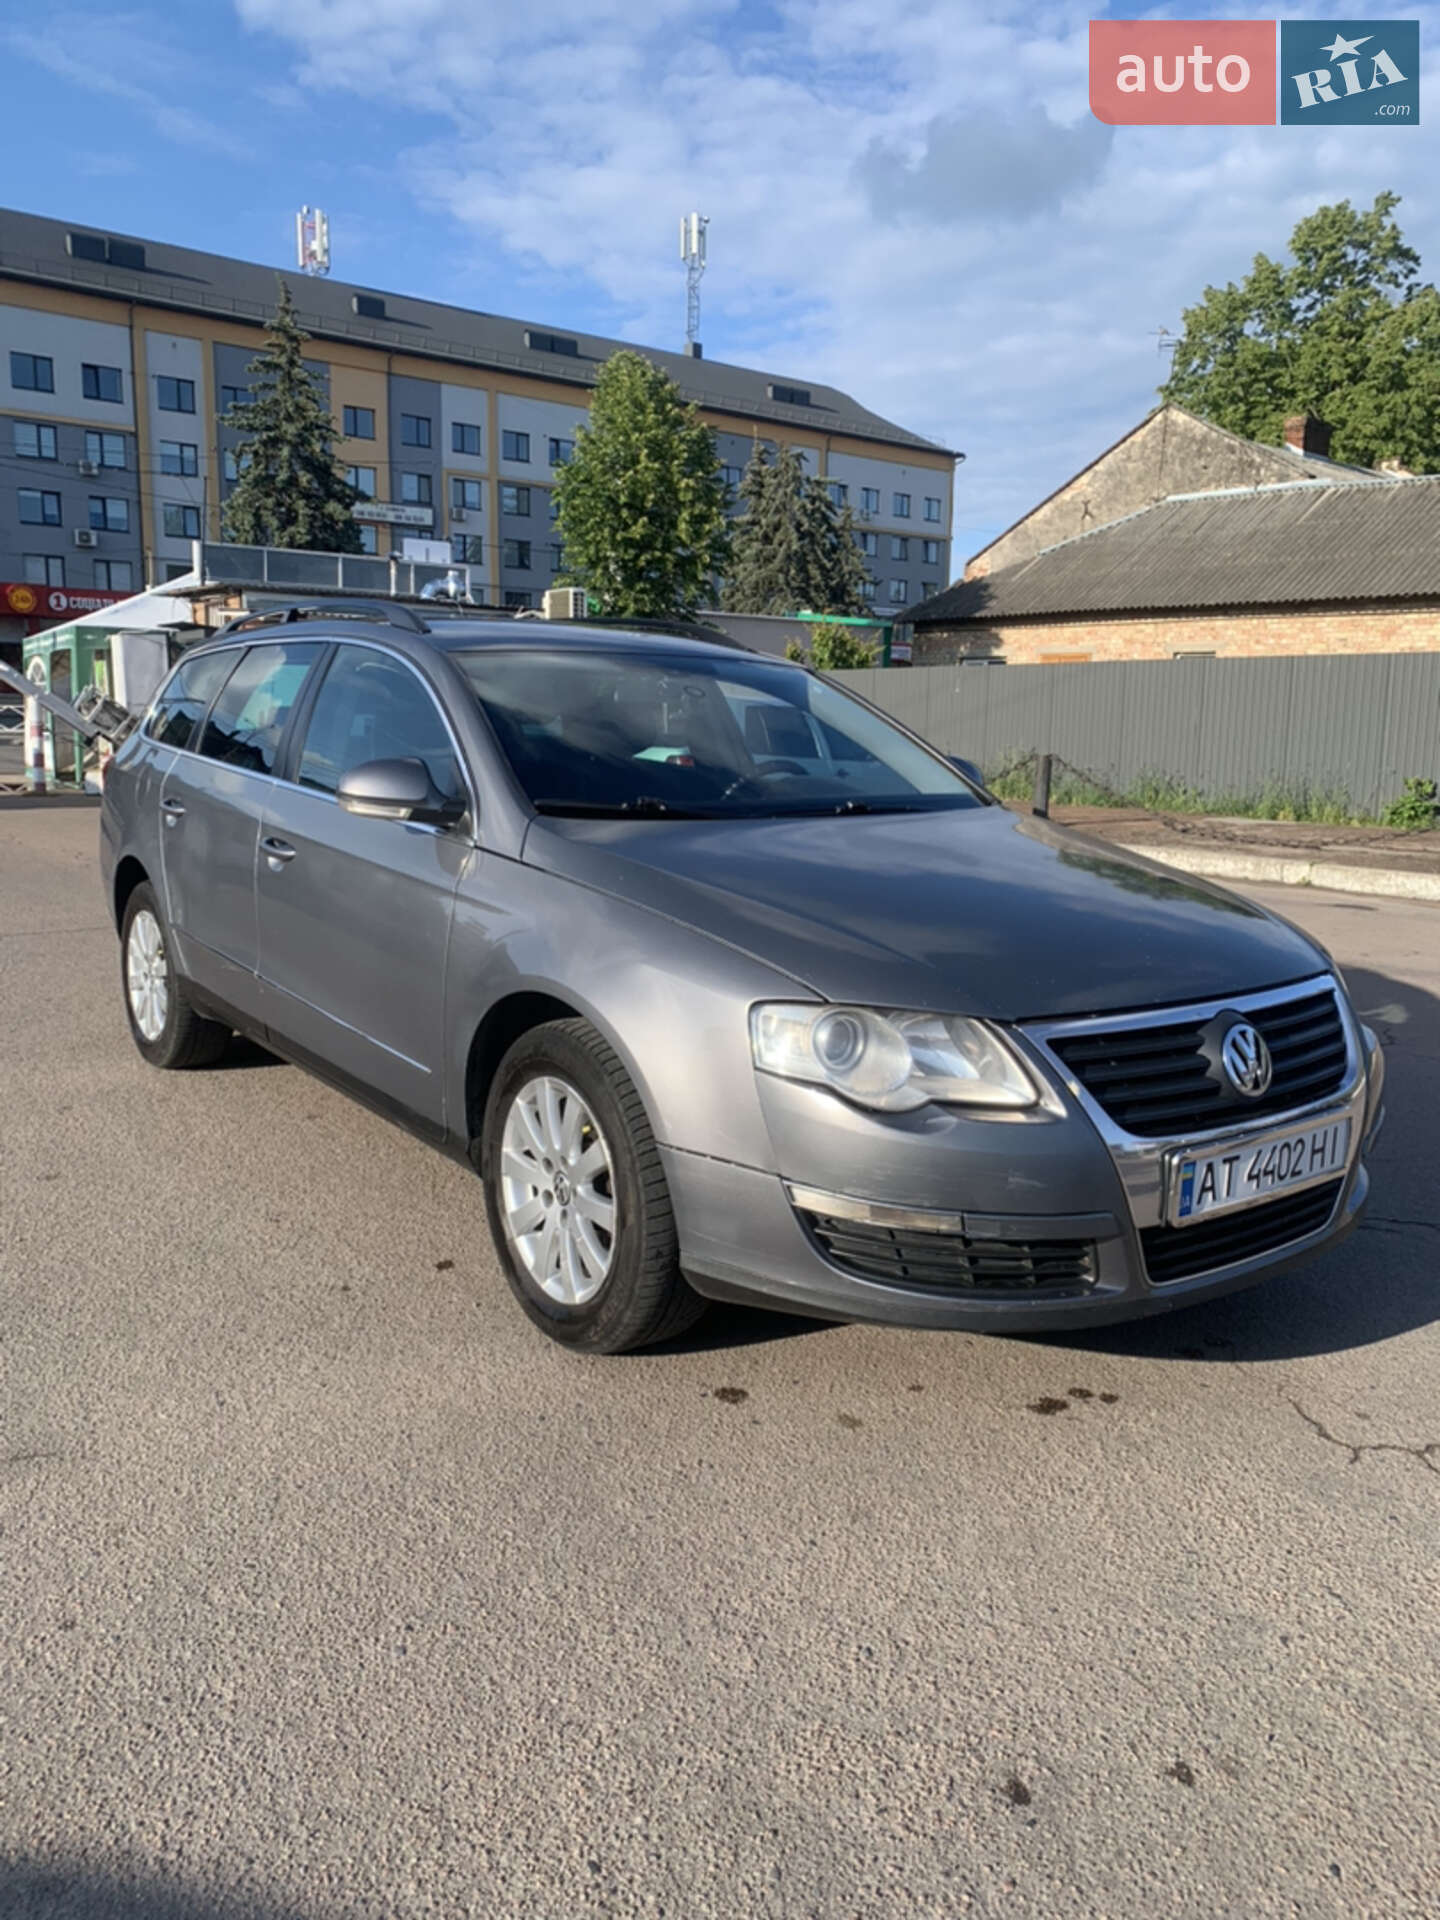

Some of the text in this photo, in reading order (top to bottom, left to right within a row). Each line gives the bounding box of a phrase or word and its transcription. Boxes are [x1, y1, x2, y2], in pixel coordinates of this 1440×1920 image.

[1196, 1125, 1339, 1205] AT 4402 HI
